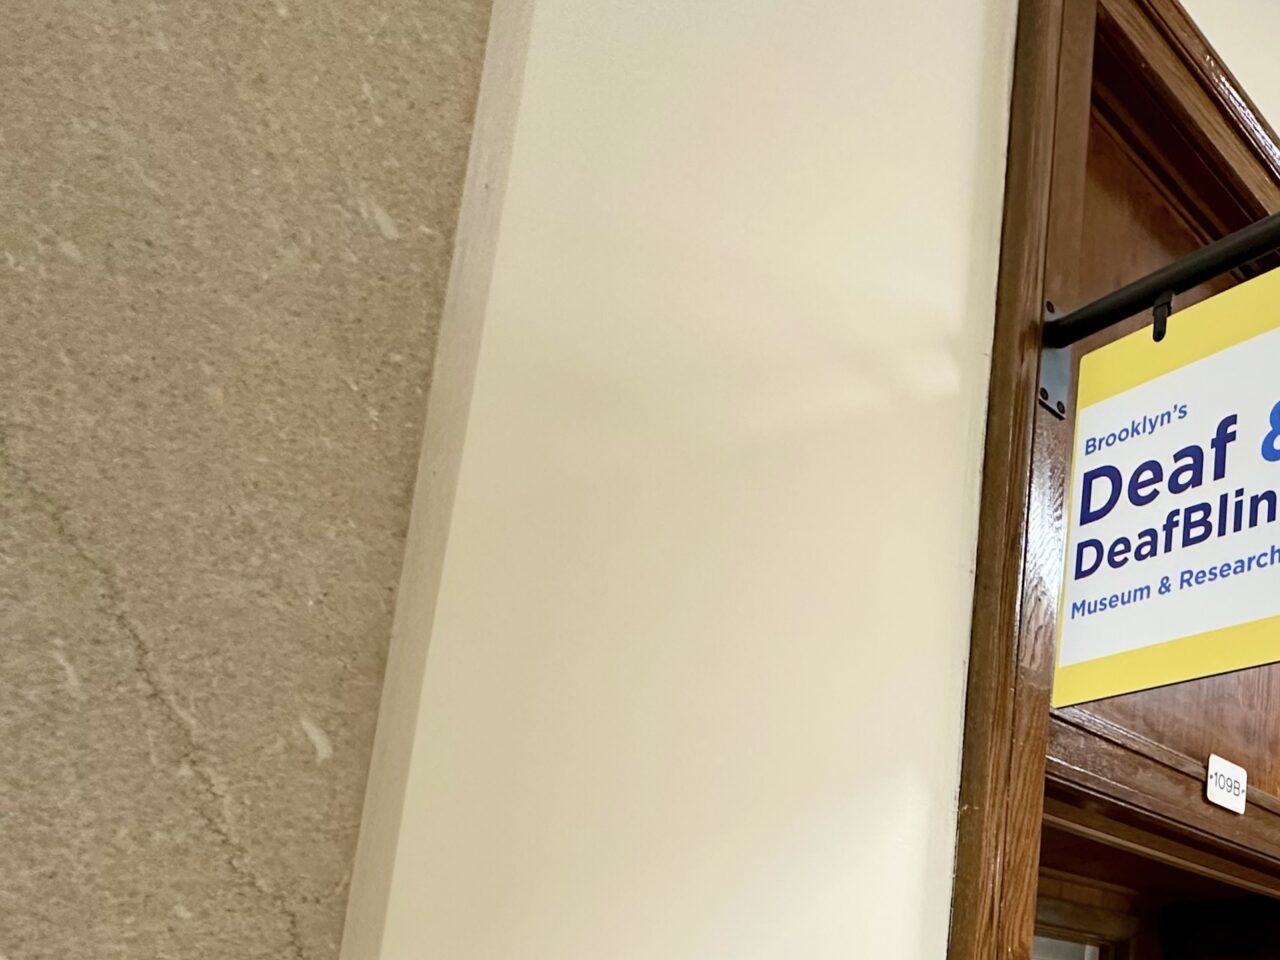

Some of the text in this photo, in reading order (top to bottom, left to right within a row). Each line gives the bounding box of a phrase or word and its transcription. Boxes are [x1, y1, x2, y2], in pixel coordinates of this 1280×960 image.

[1084, 403, 1188, 456] Brooklyn's
[1079, 414, 1238, 526] Deaf
[1071, 582, 1151, 620] Museum
[1157, 576, 1172, 596] &
